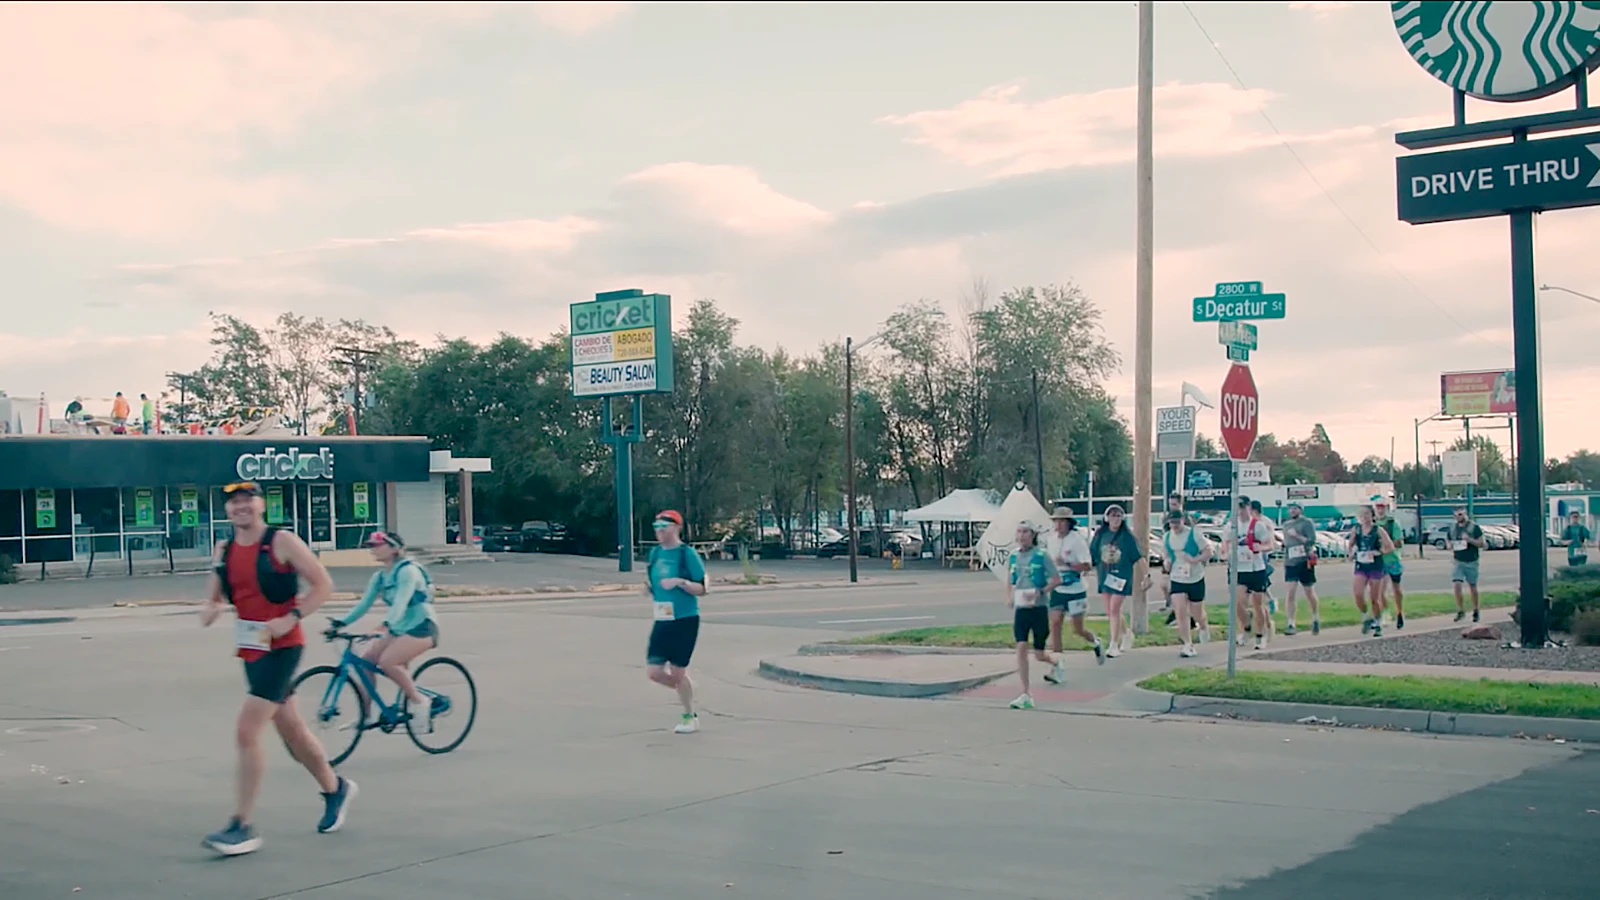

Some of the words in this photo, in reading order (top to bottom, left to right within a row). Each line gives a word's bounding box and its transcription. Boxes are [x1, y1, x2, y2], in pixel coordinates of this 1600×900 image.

[1411, 167, 1494, 198] DRIVE
[1503, 156, 1580, 186] THRU
[1218, 284, 1245, 295] 2800
[1249, 283, 1258, 293] W
[576, 299, 651, 330] cricket
[1196, 304, 1203, 315] S
[1205, 299, 1267, 318] Decatur
[1271, 300, 1283, 311] St
[574, 337, 600, 347] CAMBIO
[602, 335, 612, 344] DE
[617, 332, 652, 344] ABOGADO
[579, 345, 609, 356] CHEQUES
[590, 367, 623, 384] BEAUTY
[625, 364, 655, 381] SALON
[1160, 408, 1191, 420] YOUR
[1222, 393, 1256, 431] STOP
[1159, 420, 1192, 432] SPEED
[237, 447, 334, 480] cricket
[1243, 470, 1263, 478] 2755
